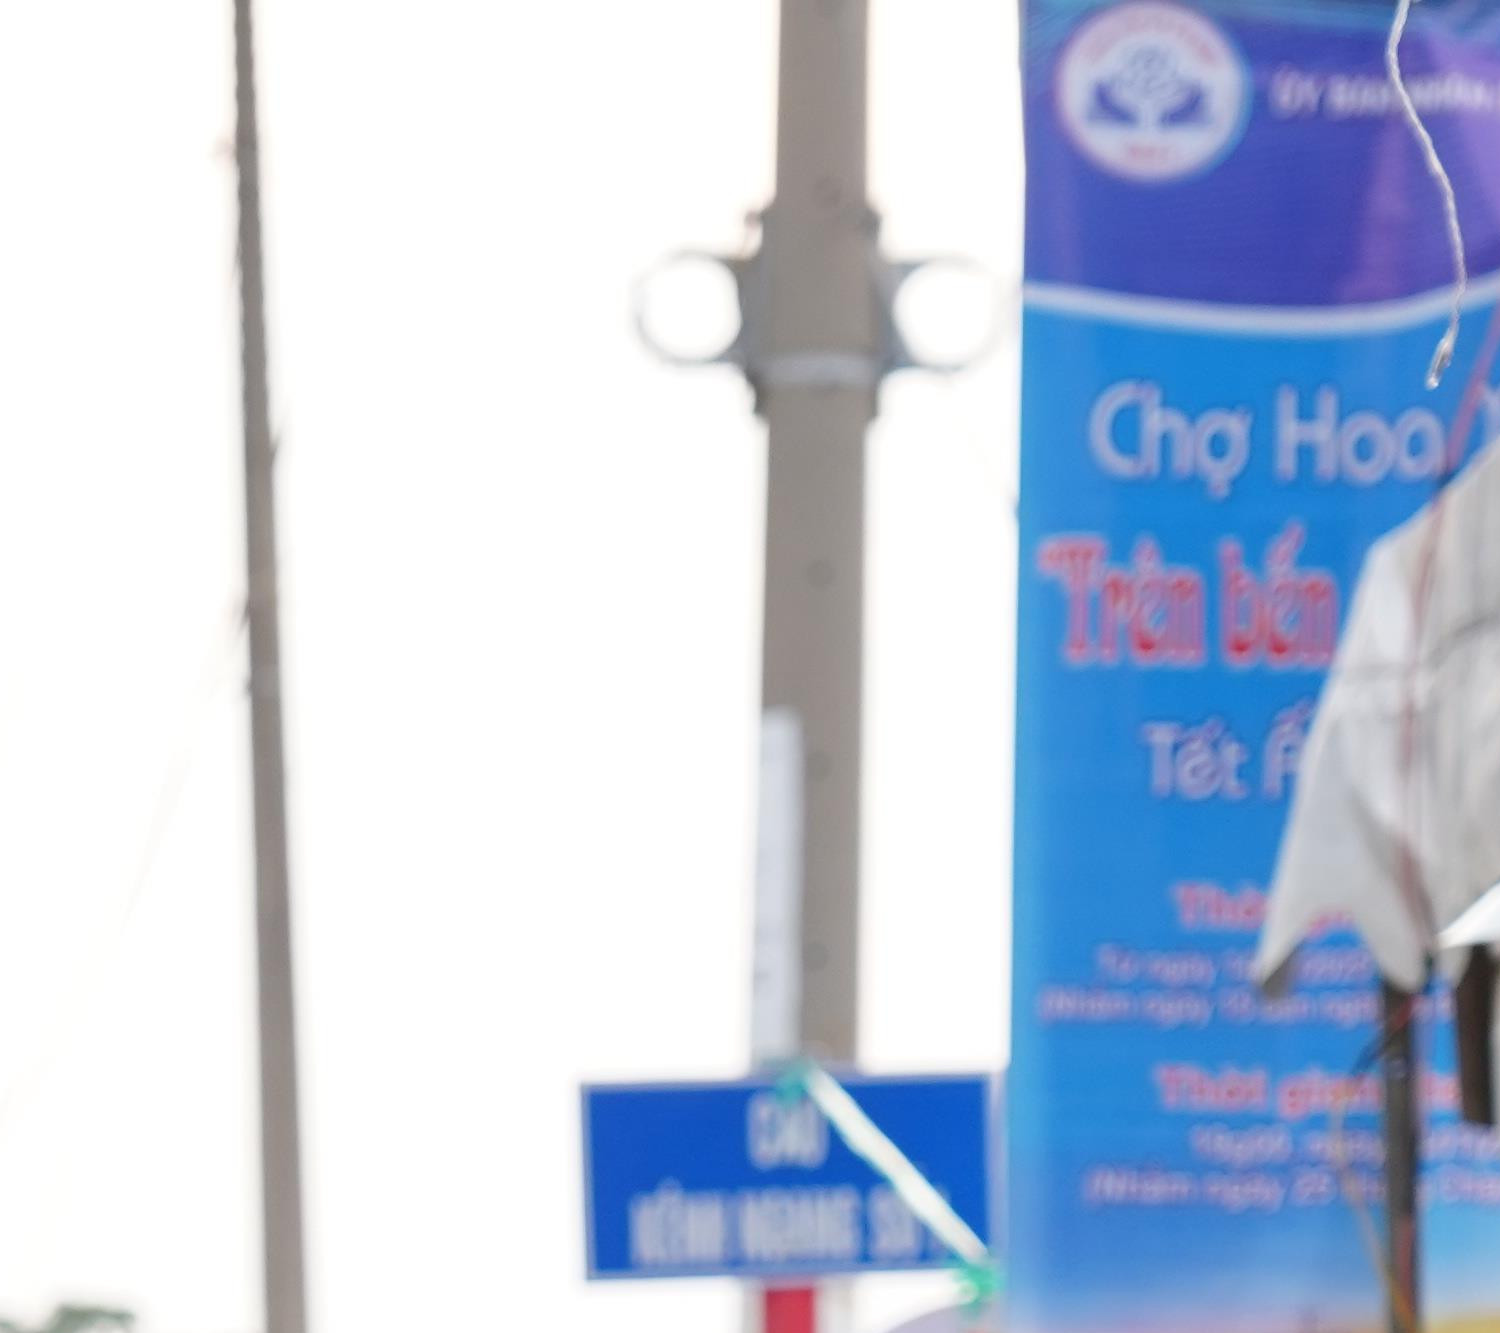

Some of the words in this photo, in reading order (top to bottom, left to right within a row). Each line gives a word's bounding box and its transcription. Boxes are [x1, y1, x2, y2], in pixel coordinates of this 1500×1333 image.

[1091, 380, 1252, 498] Chợ
[1276, 384, 1446, 483] Hoa
[1037, 532, 1204, 666] Trên
[1219, 519, 1339, 665] bến
[1143, 716, 1248, 800] Tết
